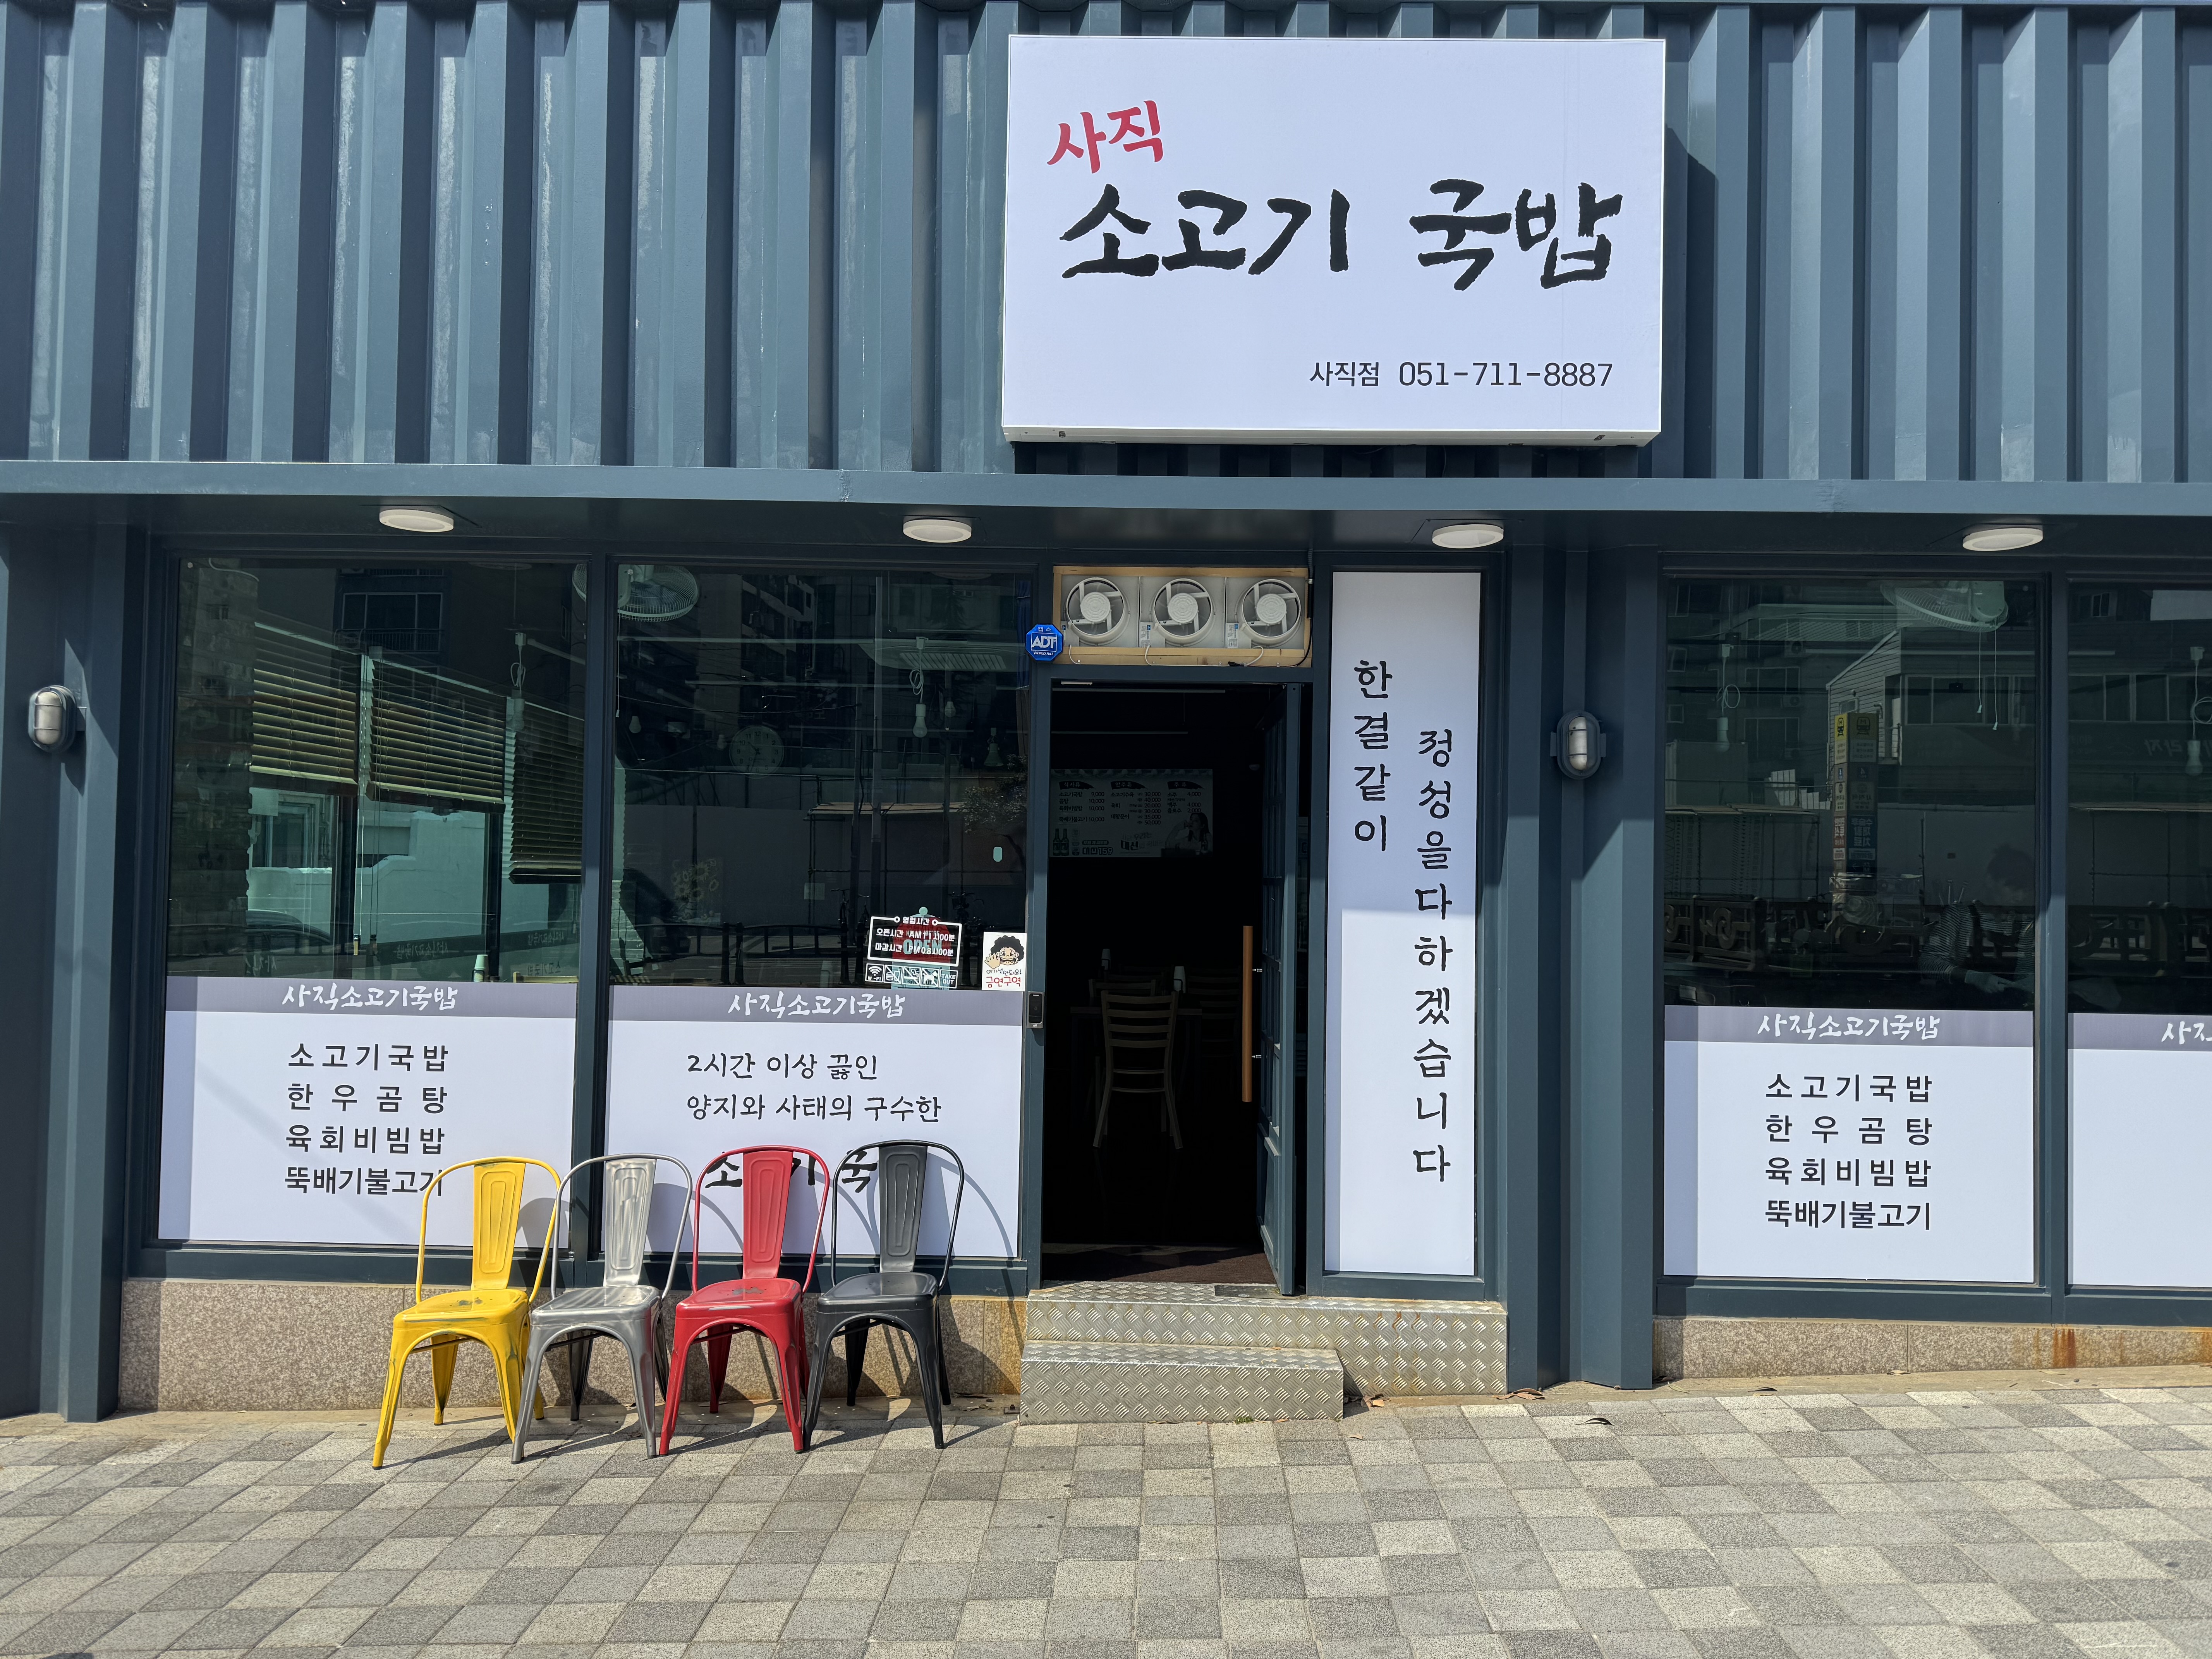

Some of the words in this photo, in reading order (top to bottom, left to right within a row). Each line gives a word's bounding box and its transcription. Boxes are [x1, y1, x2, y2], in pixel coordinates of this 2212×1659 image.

[1046, 100, 1164, 173] 사직
[1059, 183, 1350, 279] 소고기
[1409, 179, 1623, 291] 국밥
[1309, 361, 1379, 387] 사직점
[1399, 362, 1613, 387] 051-711-8887
[1031, 635, 1056, 649] ADT
[1354, 660, 1393, 852] 한결같이
[876, 928, 904, 938] 오픈시간
[909, 931, 921, 939] AM
[903, 916, 930, 926] 영업시간
[875, 942, 903, 952] 마감시간
[908, 945, 920, 953] PM
[986, 976, 1021, 988] 금연구역
[282, 982, 458, 1011] 사직소고기국밥
[728, 991, 905, 1018] 사직소고기국밥
[1757, 1012, 1940, 1040] 사직소고기국밥
[688, 1053, 756, 1079] 2시간
[767, 1053, 817, 1079] 이상
[827, 1054, 877, 1080] 끓인
[687, 1094, 766, 1120] 양지와
[776, 1094, 852, 1121] 사태의
[864, 1096, 942, 1122] 구수한
[285, 1166, 442, 1197] 뚝배기불고기
[1765, 1200, 1931, 1231] 뚝배기불고기
